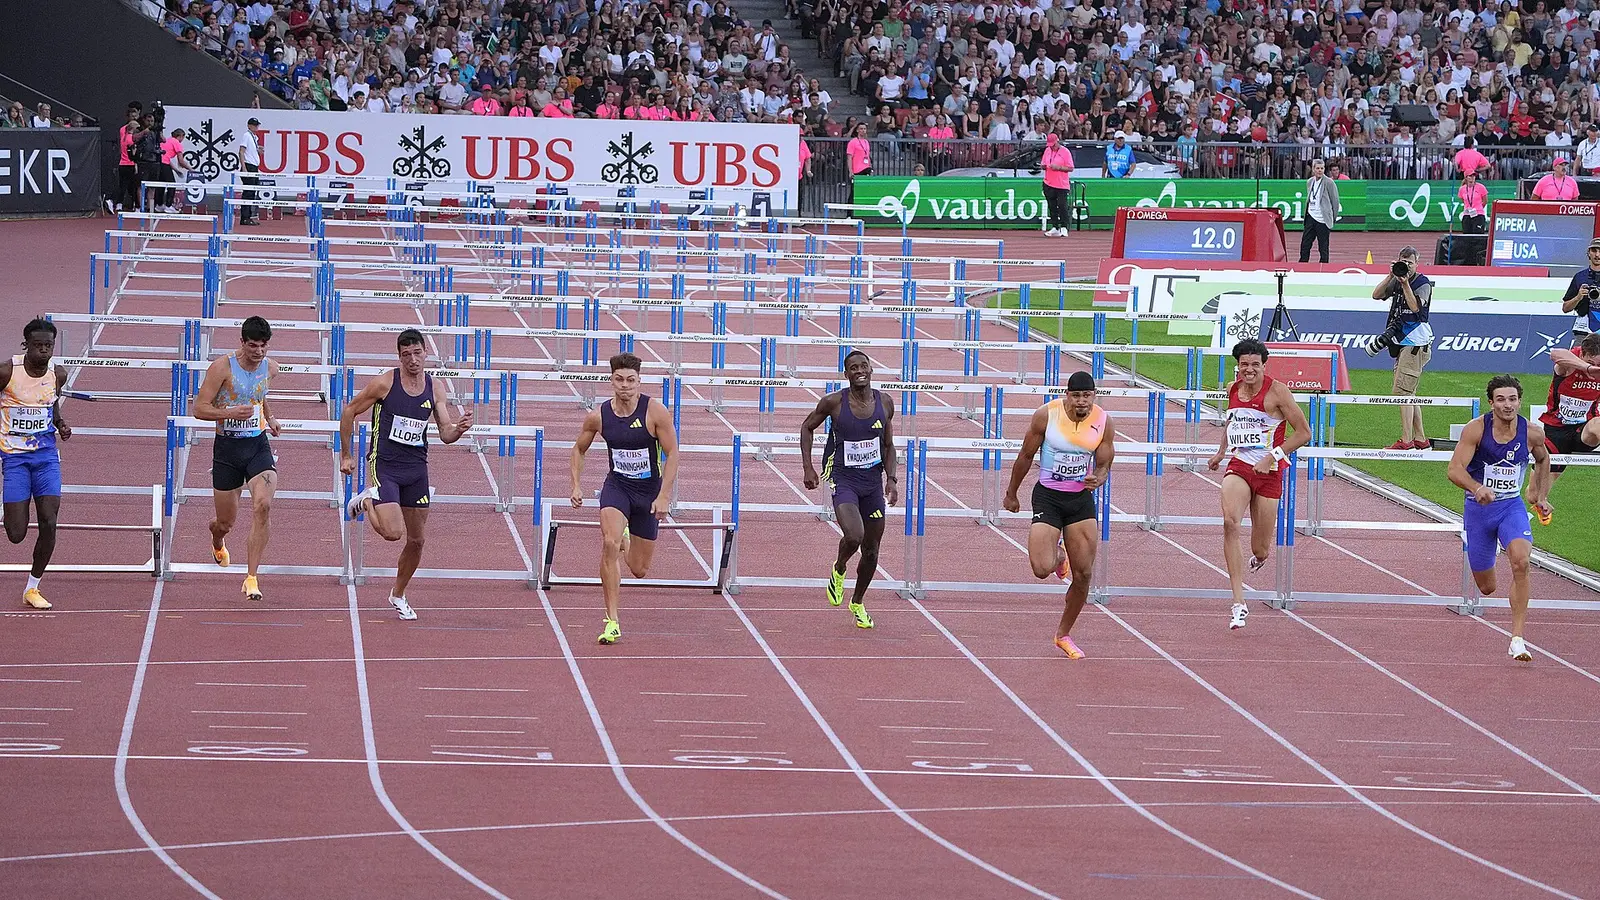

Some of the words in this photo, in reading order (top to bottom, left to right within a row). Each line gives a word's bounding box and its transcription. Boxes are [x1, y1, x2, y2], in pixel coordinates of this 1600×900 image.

[256, 130, 366, 176] UBS
[461, 135, 575, 182] UBS
[669, 141, 782, 188] UBS
[187, 179, 206, 204] 9
[928, 189, 1089, 222] vaudoie
[1567, 205, 1595, 215] OMEGA
[1137, 211, 1168, 220] OMEGA
[1495, 217, 1526, 232] PIPERI
[1527, 219, 1538, 232] A
[1191, 227, 1236, 249] 12.0
[1513, 243, 1539, 259] USA
[1437, 333, 1522, 352] ZÜRICH
[1572, 380, 1600, 390] SUISSE
[1560, 404, 1586, 418] KÜCHLER
[12, 418, 45, 430] PEDRE
[226, 418, 258, 428] MARTINEZ
[409, 420, 424, 429] UBS
[860, 441, 874, 449] UBS
[1229, 434, 1261, 444] WILKES
[1056, 462, 1088, 475] JOSEPH
